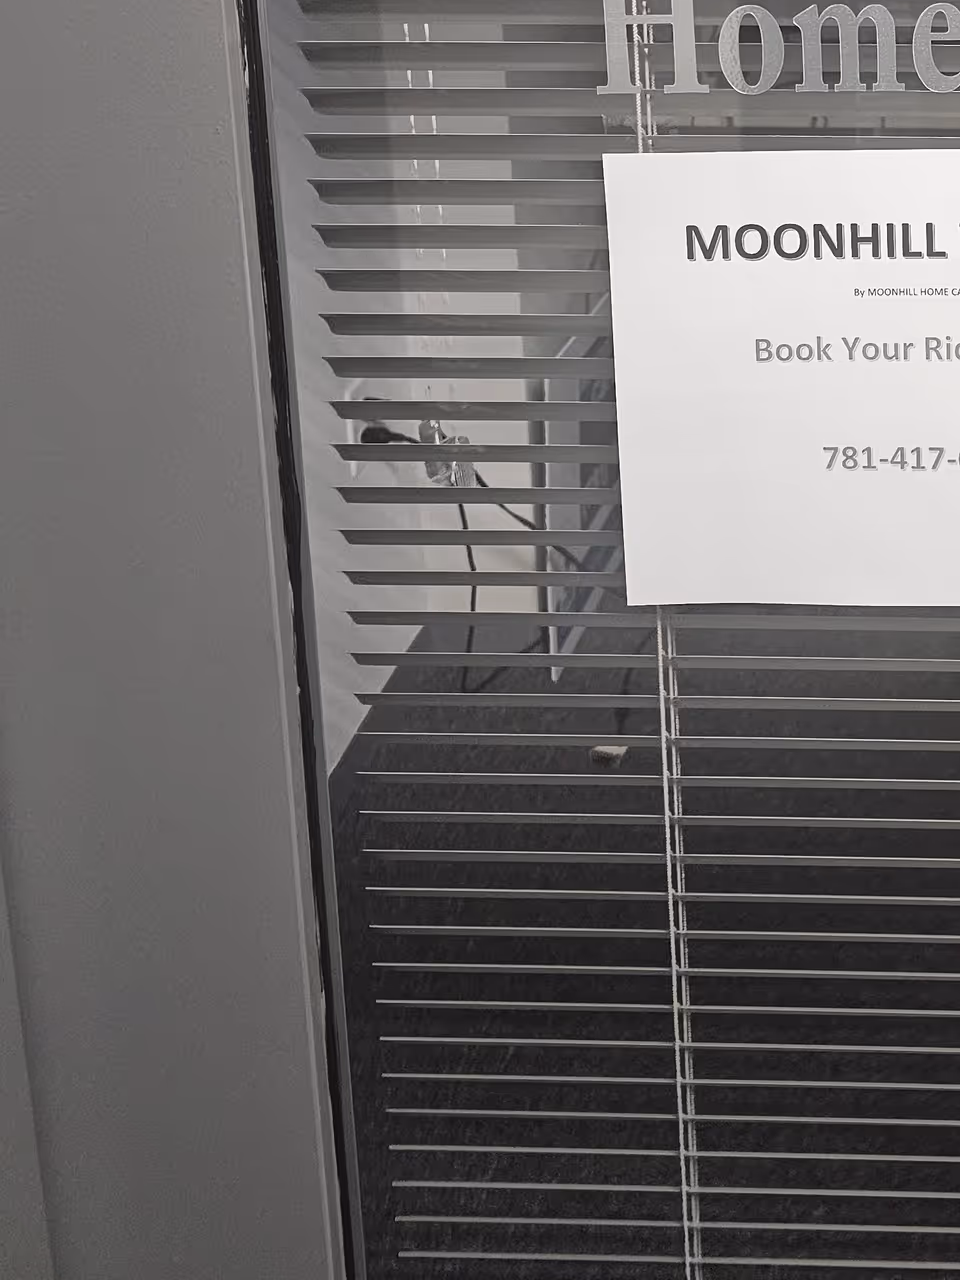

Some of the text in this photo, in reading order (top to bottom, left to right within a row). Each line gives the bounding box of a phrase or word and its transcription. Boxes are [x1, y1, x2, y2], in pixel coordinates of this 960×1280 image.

[686, 222, 948, 261] MOONHILL
[853, 288, 865, 298] By
[867, 287, 918, 297] MOONHILL
[920, 287, 949, 296] HOME
[755, 336, 834, 363] Book
[841, 336, 916, 362] Your
